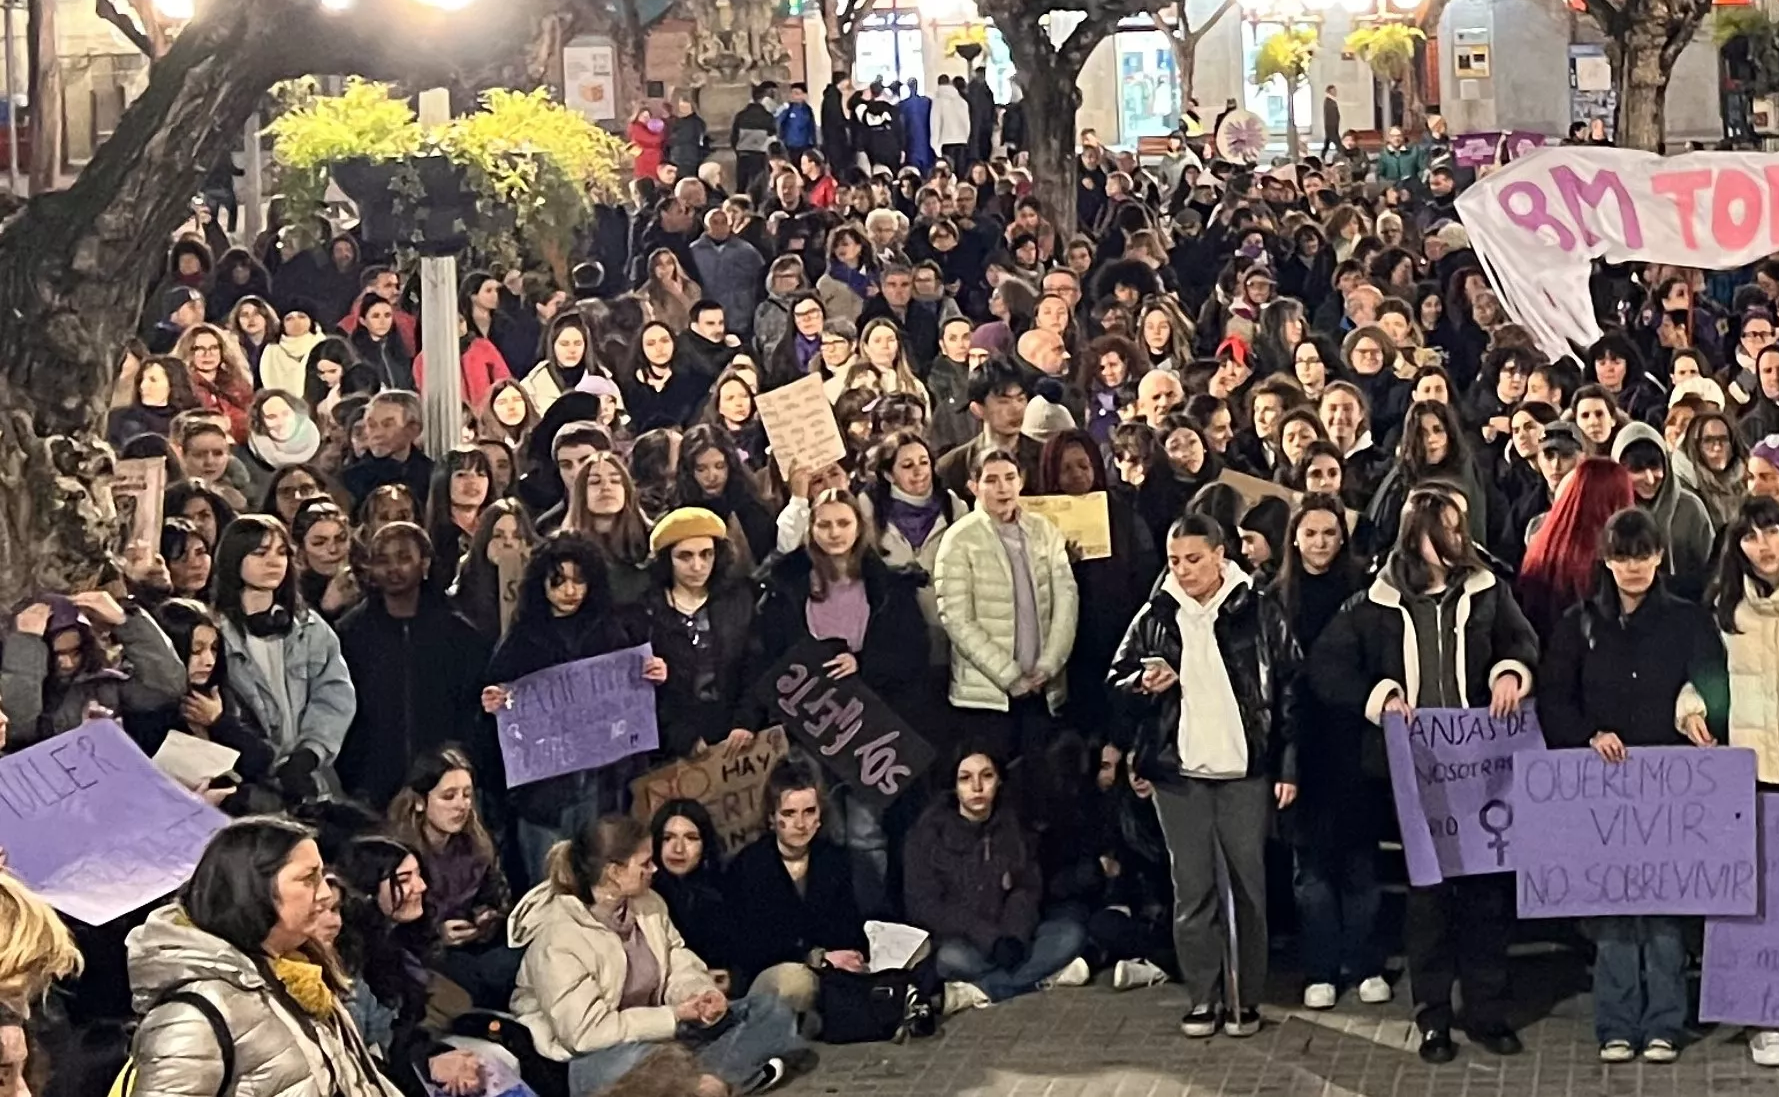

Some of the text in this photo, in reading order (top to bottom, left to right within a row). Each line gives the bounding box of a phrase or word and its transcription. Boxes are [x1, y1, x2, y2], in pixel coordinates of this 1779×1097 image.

[721, 751, 770, 782] HAY
[1525, 754, 1717, 802] QUEREMOS
[1590, 803, 1709, 846] VIVIR
[1524, 859, 1754, 905] NO SOBREVIVIR
